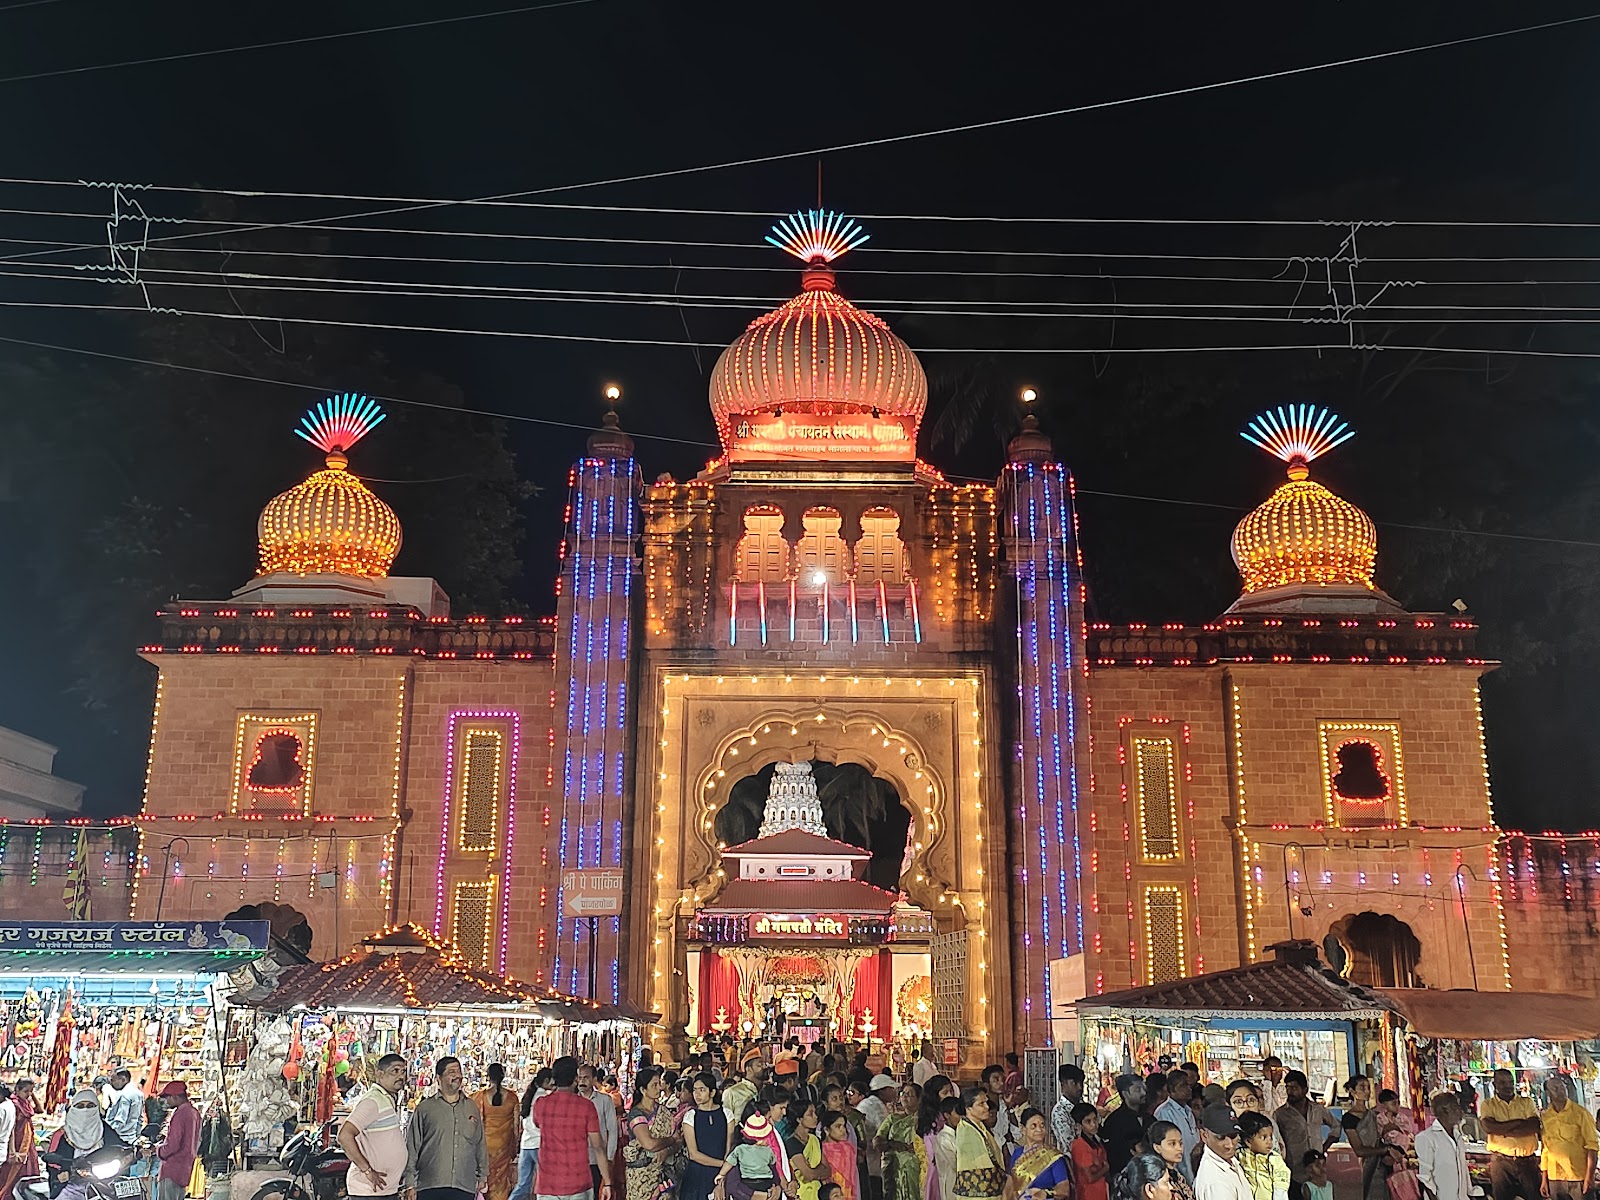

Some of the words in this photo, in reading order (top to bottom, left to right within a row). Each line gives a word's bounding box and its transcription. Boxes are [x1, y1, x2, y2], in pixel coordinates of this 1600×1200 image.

[736, 420, 750, 439] श्री
[563, 872, 576, 890] श्री
[0, 927, 21, 943] र
[28, 927, 115, 942] गजराज
[120, 922, 187, 942] स्टॉल
[755, 918, 770, 934] श्री
[771, 918, 812, 934] गणपती
[814, 918, 843, 935] मंदिर
